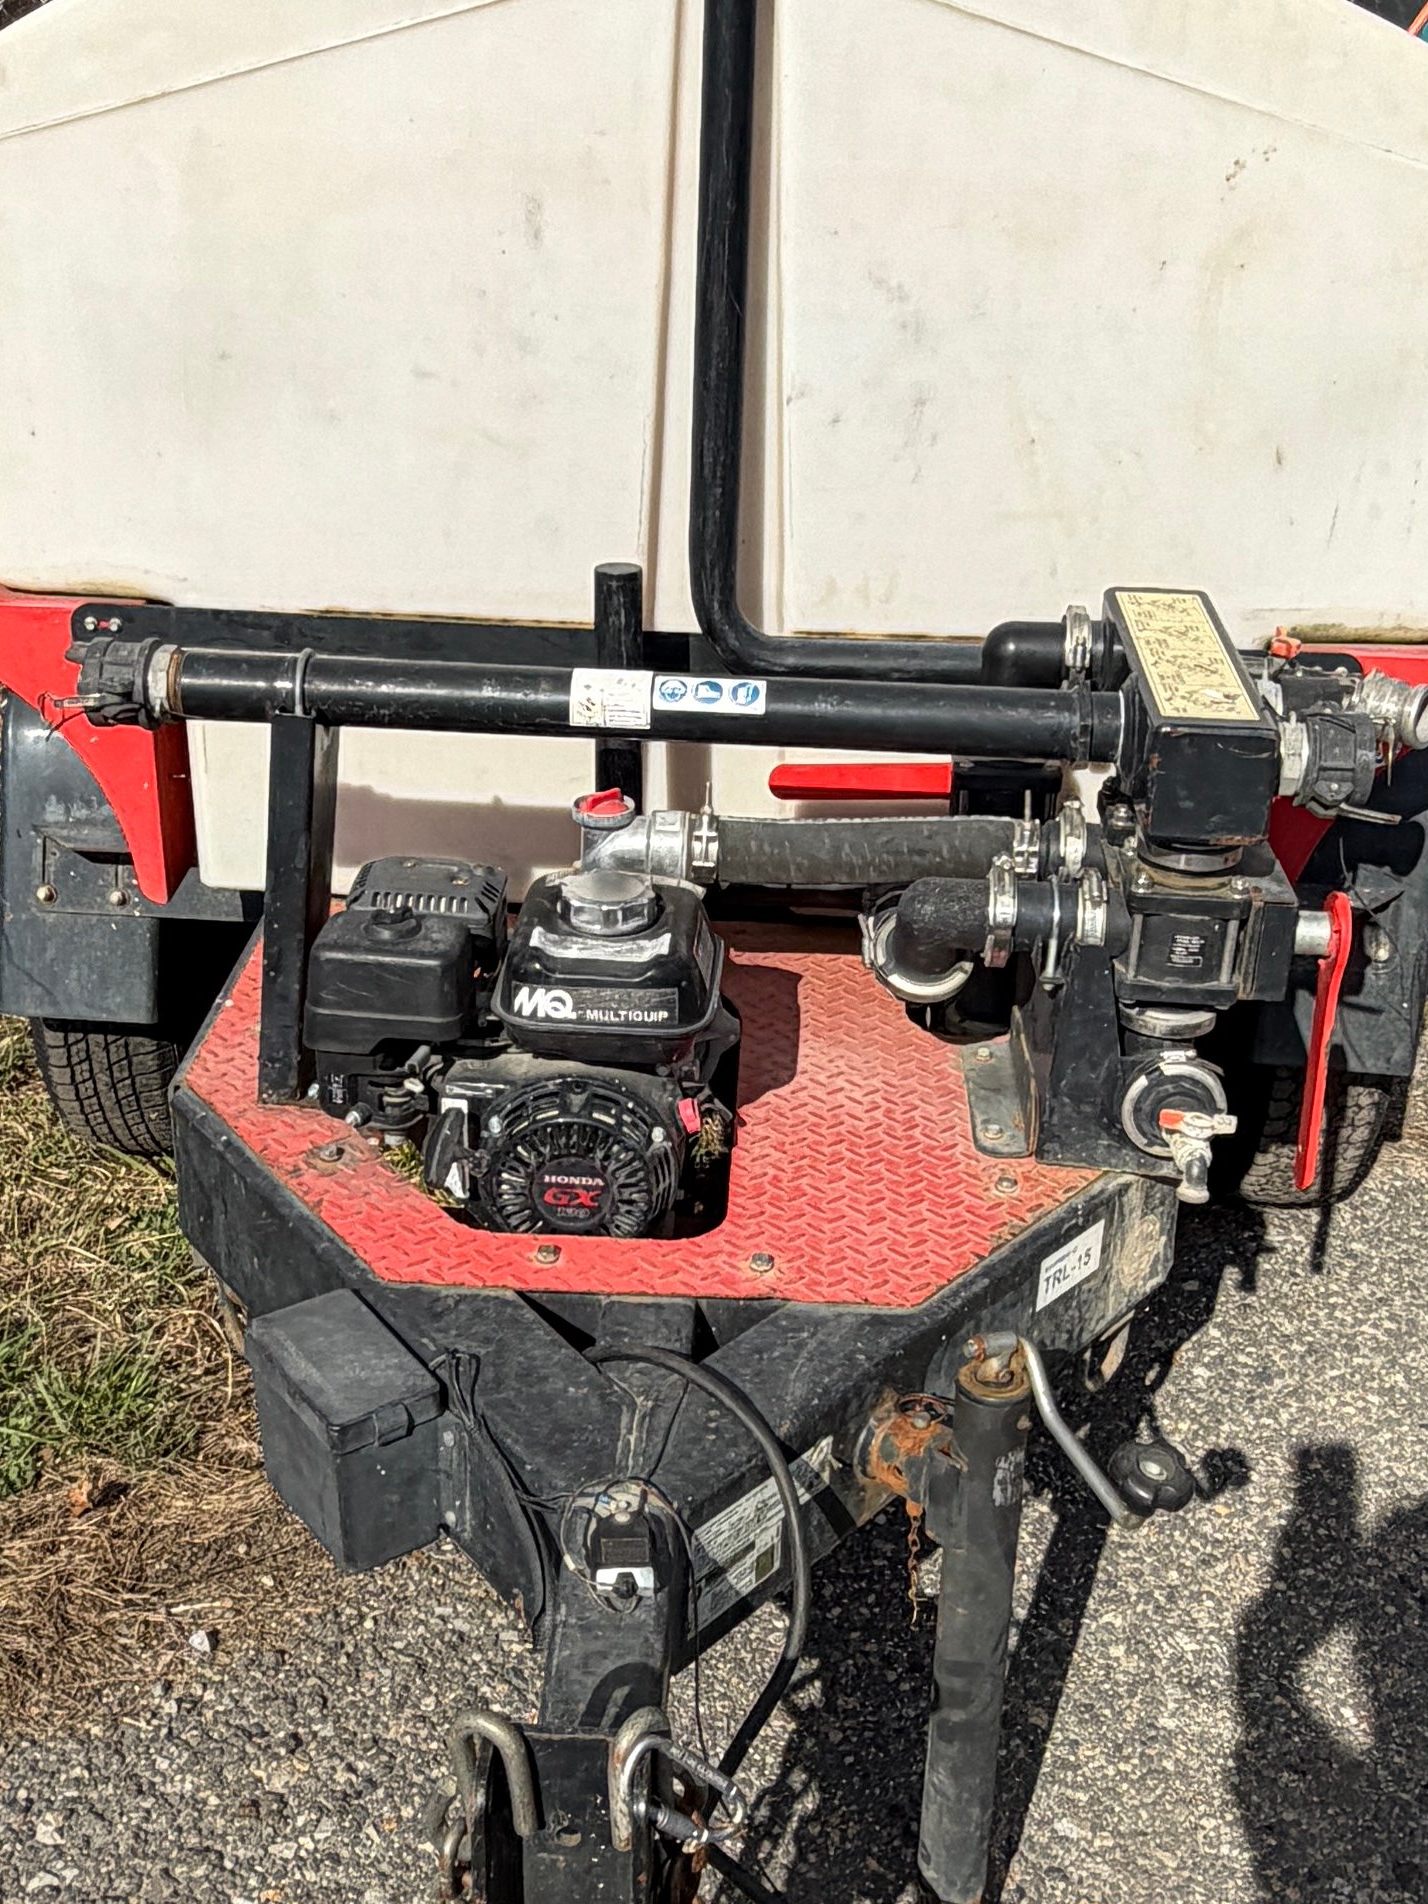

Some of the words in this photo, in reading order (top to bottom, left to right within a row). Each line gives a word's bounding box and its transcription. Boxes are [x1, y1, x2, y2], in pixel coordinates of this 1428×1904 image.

[585, 1009, 669, 1023] MULTIQUIP
[543, 1175, 606, 1187] HONDA
[543, 1187, 602, 1208] GX
[1043, 1246, 1093, 1295] TRL-15
